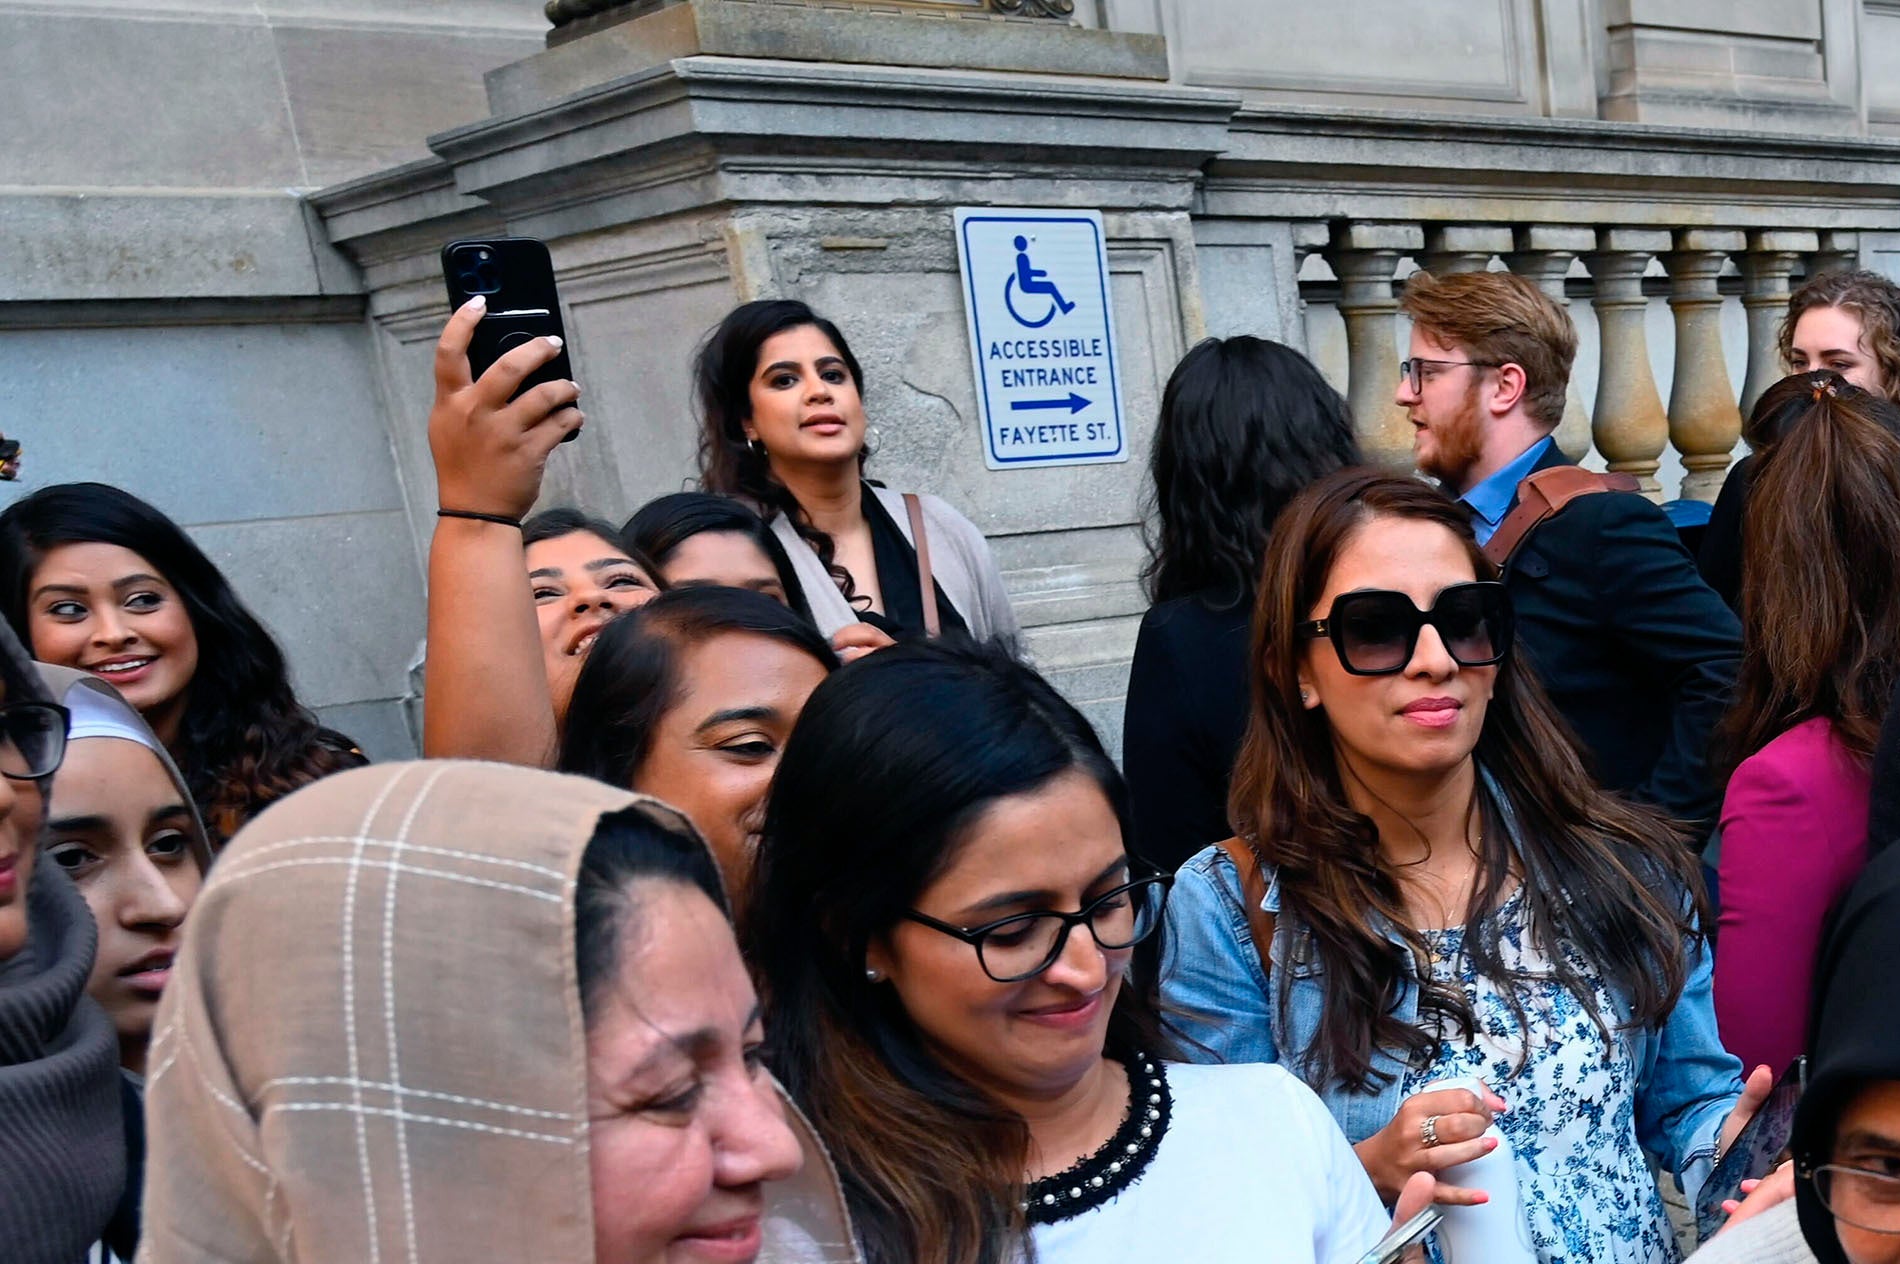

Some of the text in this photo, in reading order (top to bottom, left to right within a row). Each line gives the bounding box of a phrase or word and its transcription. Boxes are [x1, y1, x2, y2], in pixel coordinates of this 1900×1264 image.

[990, 338, 1103, 360] ACCESSIBLE
[1001, 366, 1098, 388] ENTRANCE
[1000, 422, 1112, 445] FAYETTE ST.
